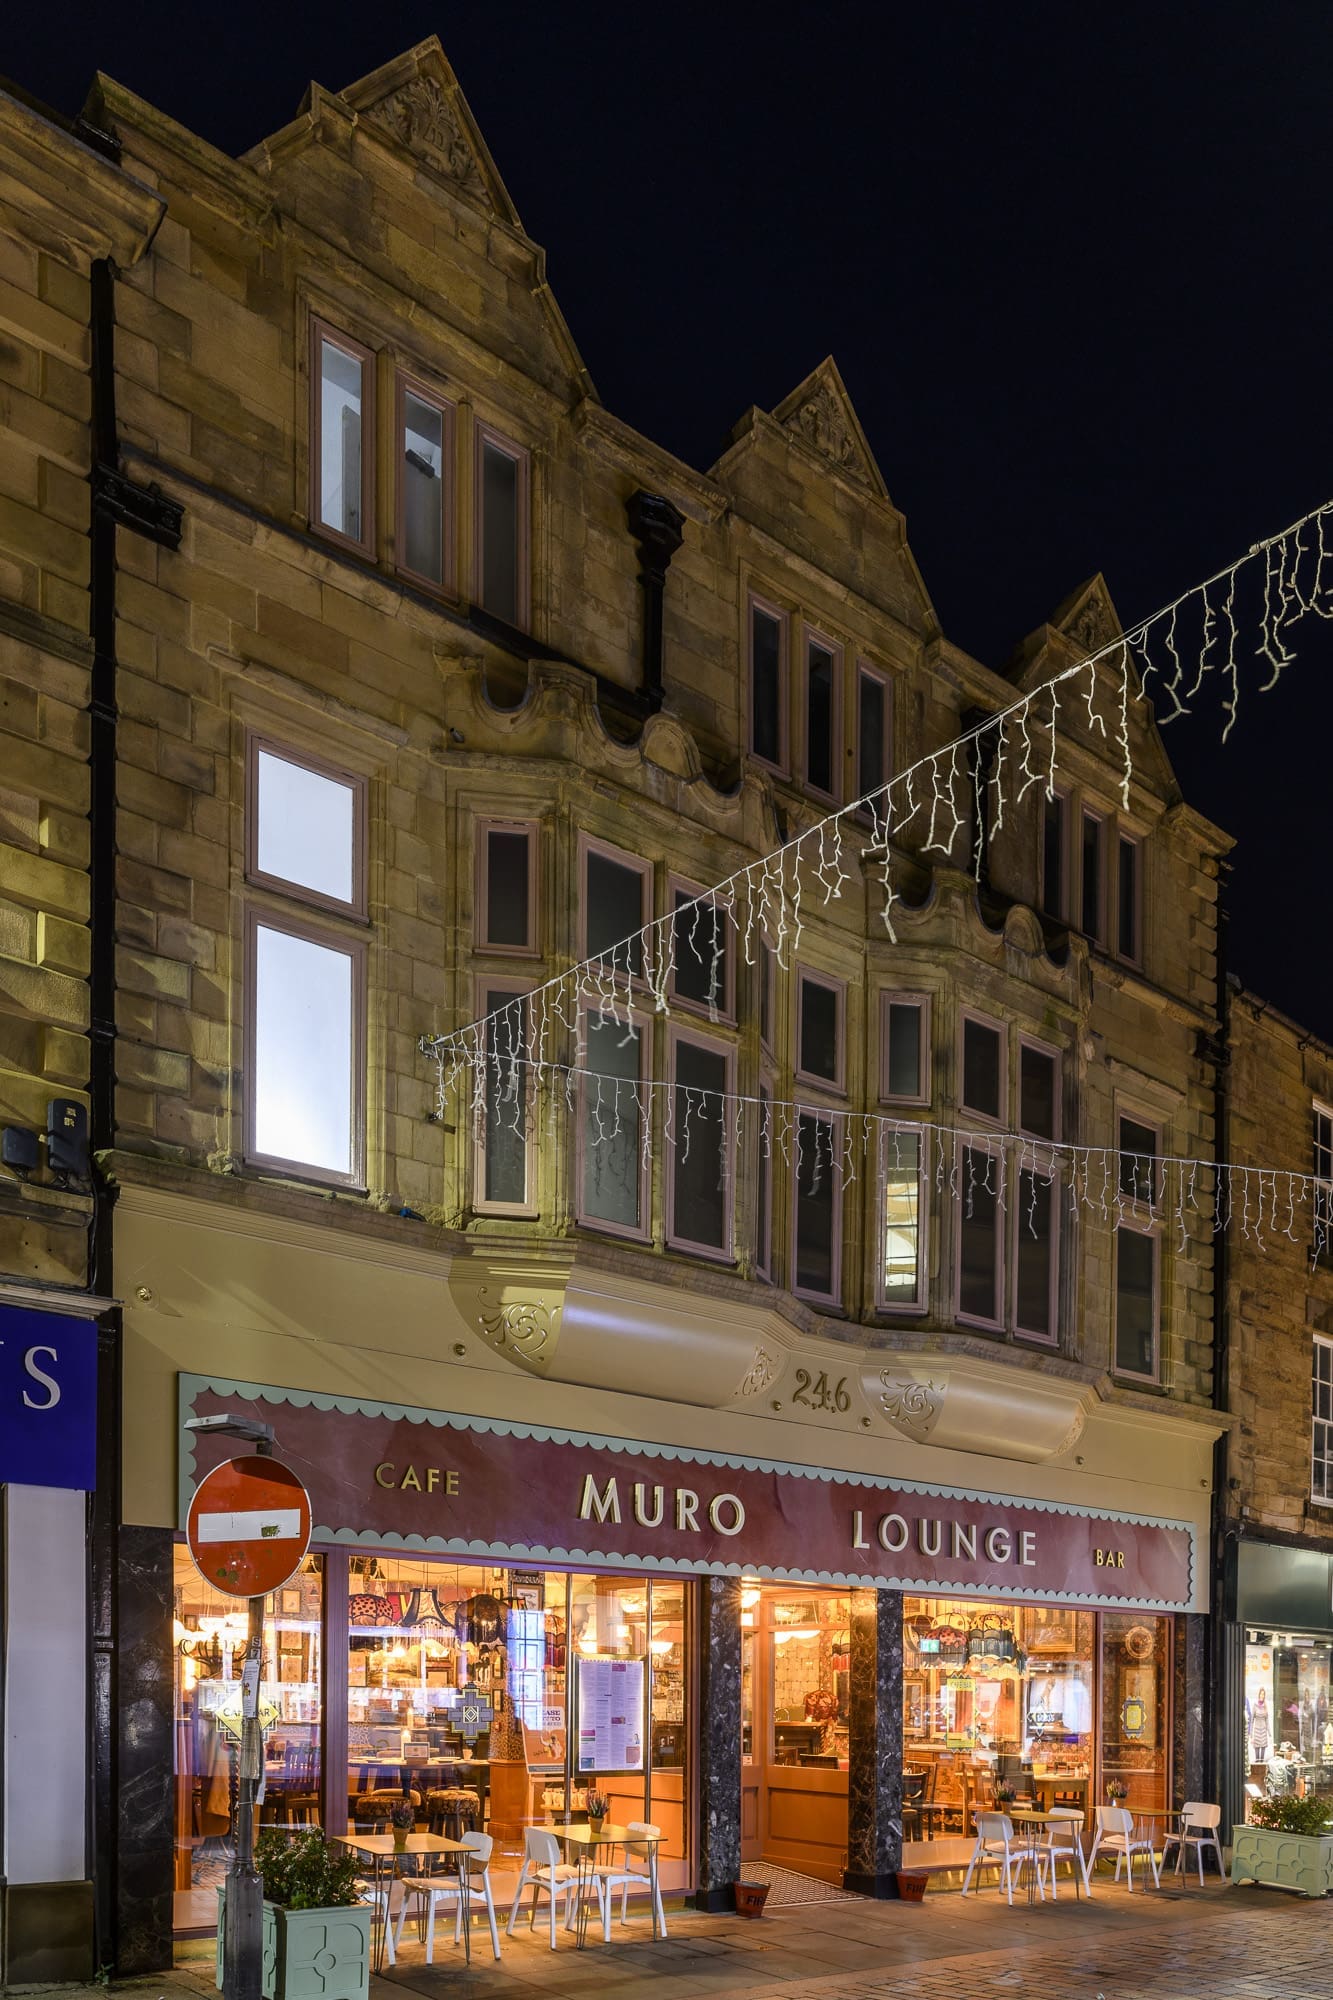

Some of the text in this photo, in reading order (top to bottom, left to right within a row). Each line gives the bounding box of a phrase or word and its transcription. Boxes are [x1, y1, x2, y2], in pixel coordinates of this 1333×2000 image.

[376, 1462, 1125, 1569] CAFE MURO LOUNGE BAR
[223, 1707, 243, 1717] CAF
